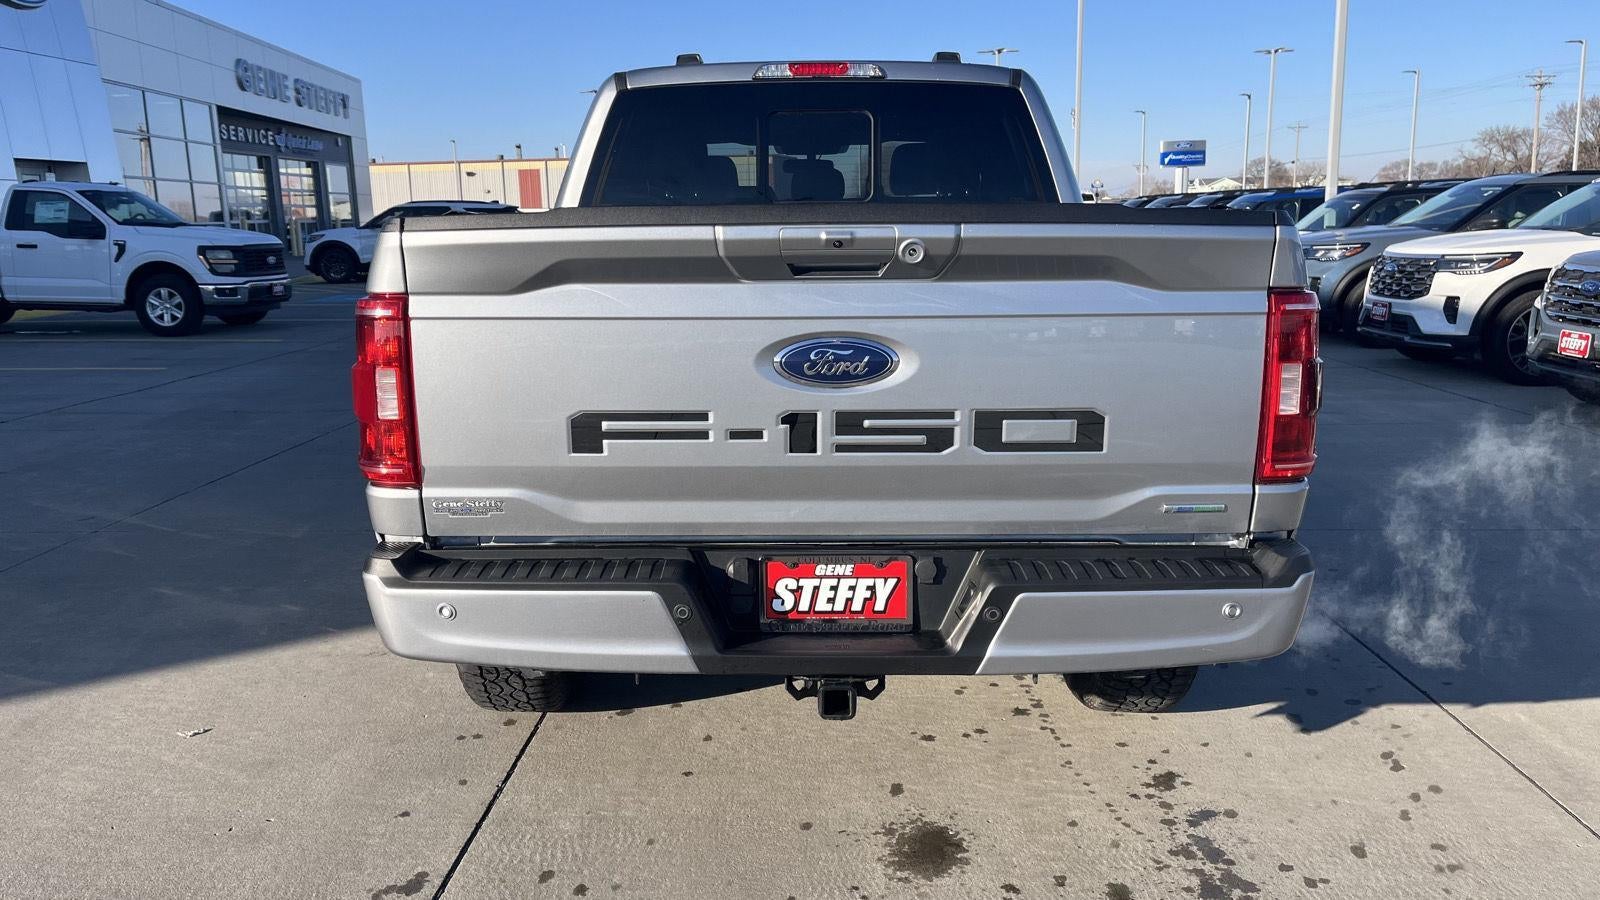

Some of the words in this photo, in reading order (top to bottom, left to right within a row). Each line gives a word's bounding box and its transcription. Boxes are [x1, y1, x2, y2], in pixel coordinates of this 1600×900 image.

[234, 58, 291, 103] GENE
[293, 78, 350, 119] STEFFY
[220, 124, 275, 146] SERVICE
[1560, 336, 1587, 351] STEFFY
[803, 348, 870, 376] Ford
[568, 409, 1107, 455] F-150
[432, 499, 464, 508] Gene
[464, 498, 505, 508] Steffy
[814, 564, 855, 576] GENE
[772, 577, 898, 612] STEFFY
